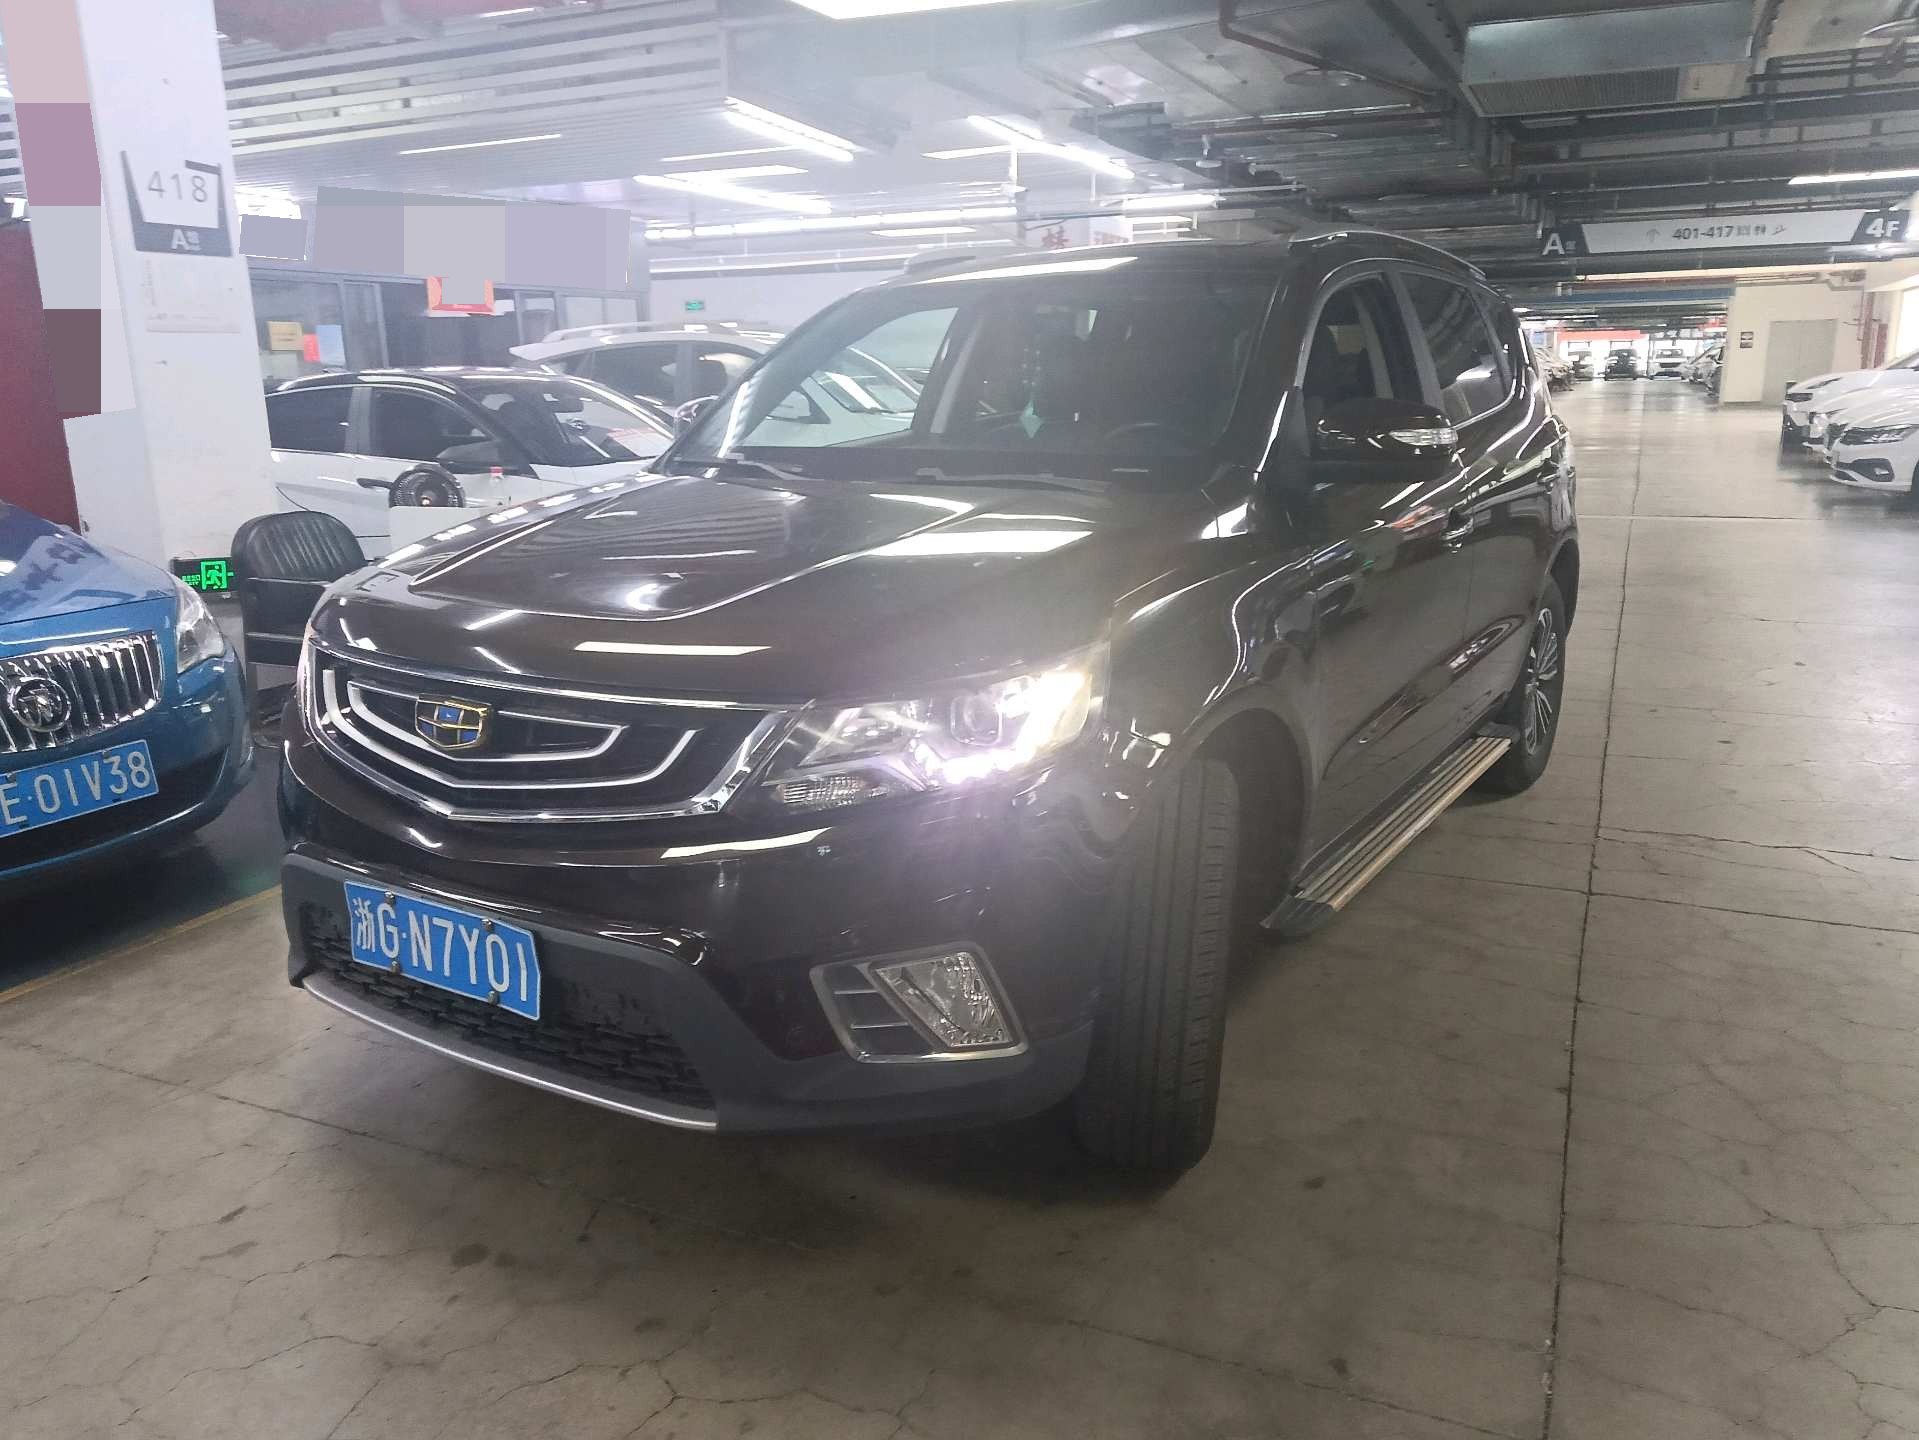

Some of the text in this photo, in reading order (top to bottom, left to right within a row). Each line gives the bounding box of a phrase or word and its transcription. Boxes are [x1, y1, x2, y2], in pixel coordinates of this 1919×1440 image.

[147, 171, 208, 203] 418
[1671, 225, 1734, 240] 401-417
[1865, 217, 1901, 239] 4F
